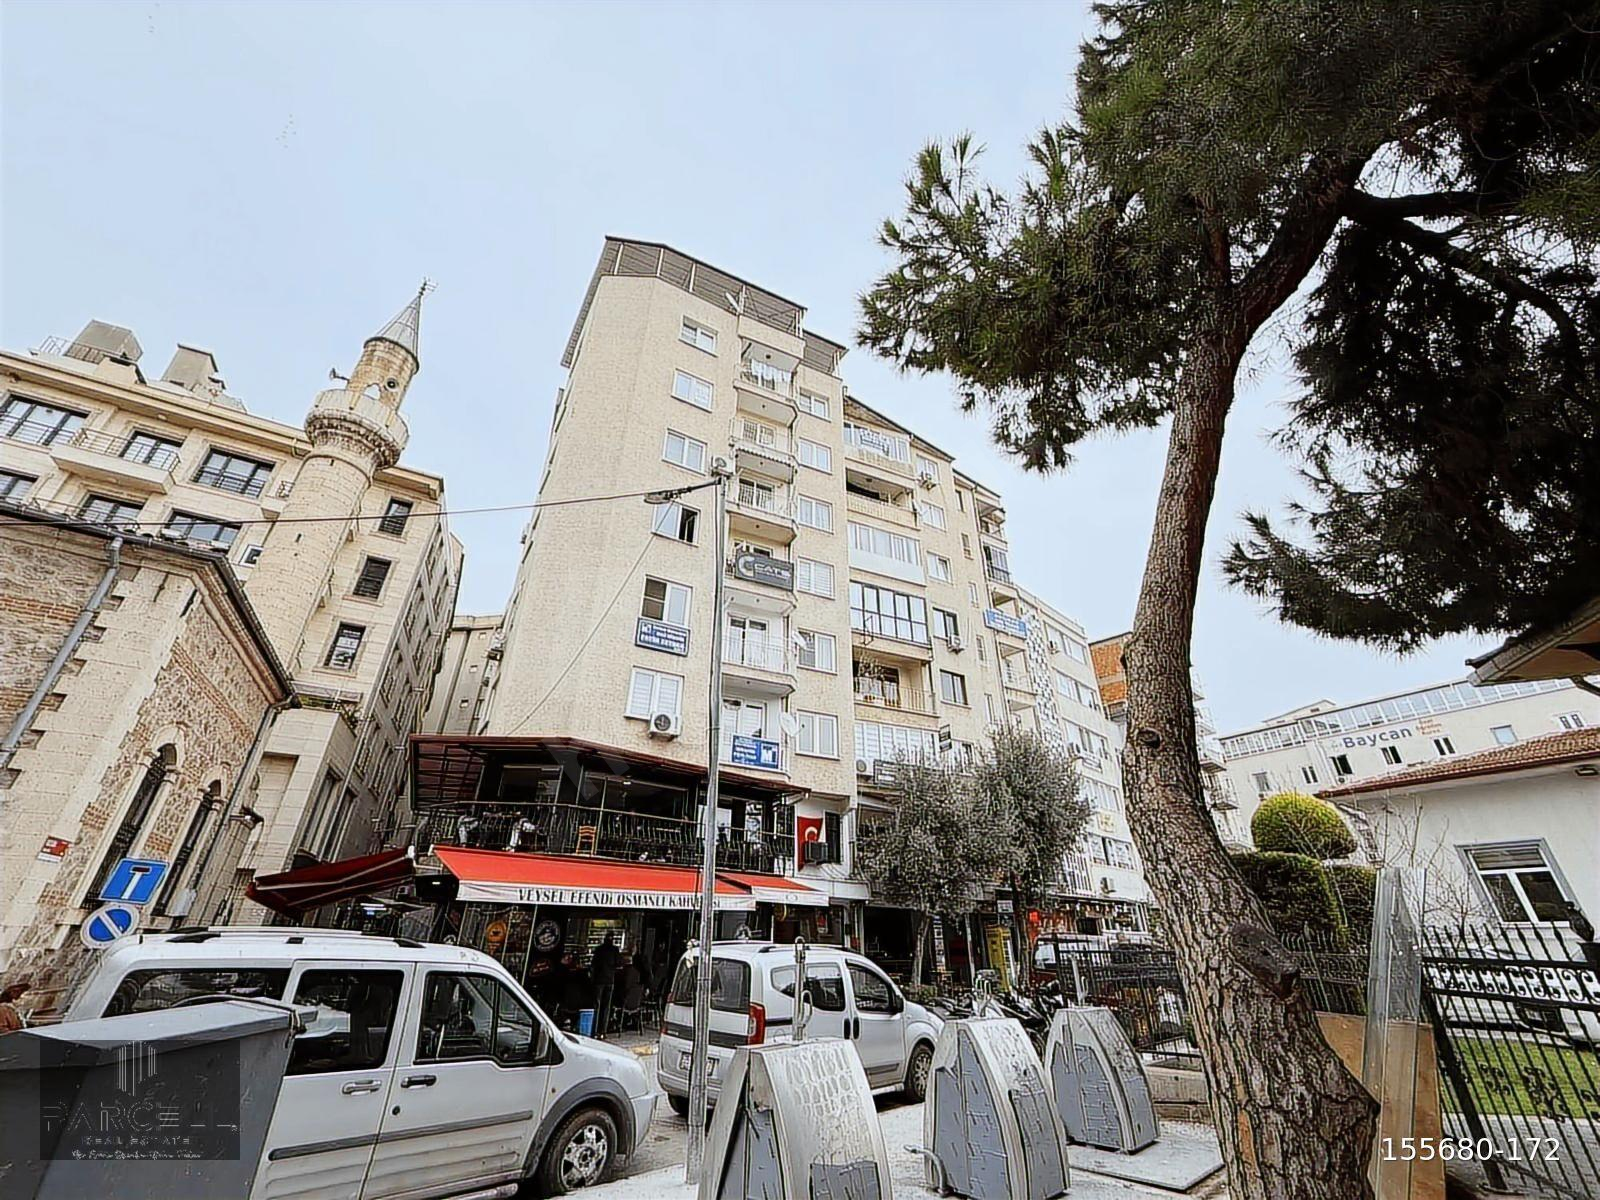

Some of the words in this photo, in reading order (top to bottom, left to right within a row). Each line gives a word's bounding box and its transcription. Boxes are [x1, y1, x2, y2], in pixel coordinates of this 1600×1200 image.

[1342, 727, 1412, 748] Baycan
[518, 888, 564, 903] VEYSEL
[617, 892, 665, 907] OSMANLI
